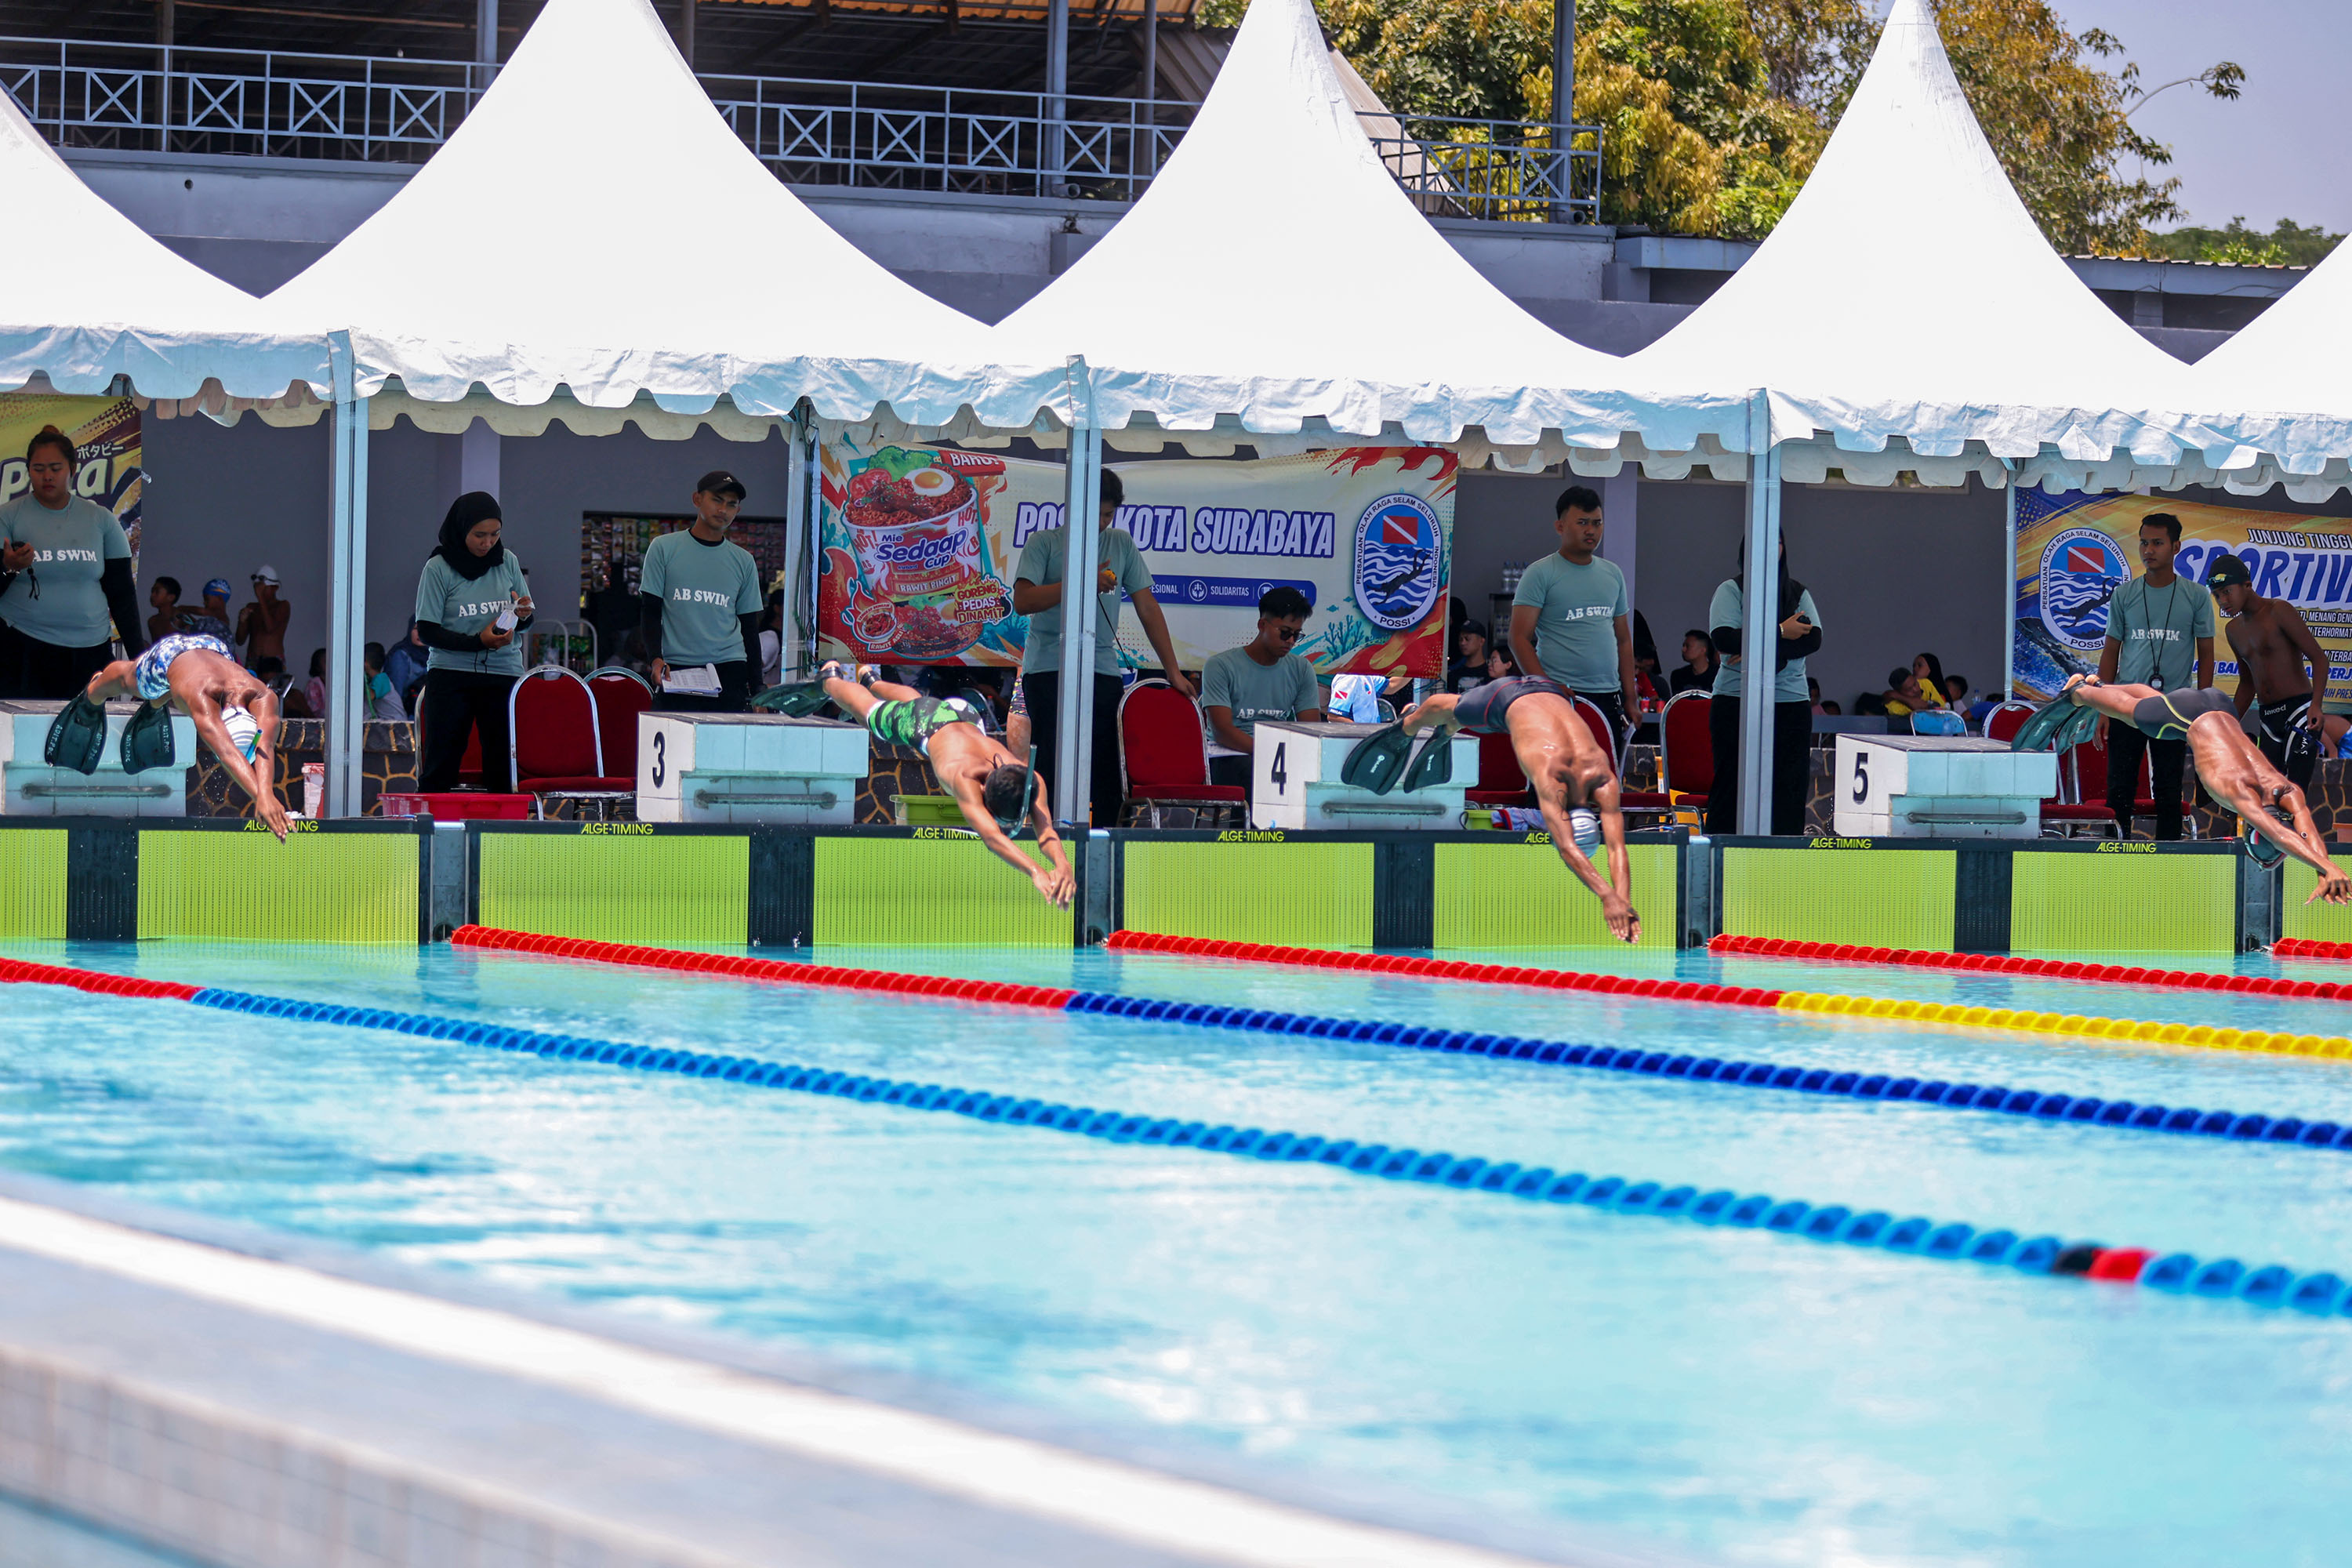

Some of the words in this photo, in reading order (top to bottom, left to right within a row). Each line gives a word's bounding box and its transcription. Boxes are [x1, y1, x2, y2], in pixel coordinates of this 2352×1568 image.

[77, 441, 124, 459] ポタビー
[1359, 511, 1373, 533] OLAH
[1372, 498, 1392, 512] RAGA
[1392, 496, 1416, 506] SELAM
[1417, 503, 1439, 537] SELURUH
[1113, 506, 1186, 552] KOTA
[1192, 506, 1334, 558] SURABAYA
[2248, 528, 2306, 547] JUNJUNG
[876, 529, 967, 562] Sedaap
[2043, 543, 2056, 563] OLAH
[2056, 531, 2075, 544] RAGA
[2075, 530, 2100, 539] SELAM
[2100, 536, 2126, 567] SELURUH
[32, 550, 53, 562] AB
[57, 550, 97, 562] SWIM
[924, 554, 950, 568] Cup
[900, 583, 929, 593] RAWIT
[956, 583, 997, 600] GORENG
[1210, 586, 1250, 597] SOLIDARITAS
[673, 588, 691, 601] AB
[694, 590, 730, 607] SWIM
[963, 596, 996, 611] PEDAS
[458, 603, 477, 617] AB
[957, 608, 1004, 625] DINAMIT
[1566, 608, 1584, 620] AB
[2308, 612, 2336, 622] MENANG
[1379, 616, 1411, 627] POSSI
[2131, 629, 2145, 640] AB
[2147, 629, 2180, 641] SWIM
[652, 731, 666, 789] 3
[1271, 742, 1287, 795] 4
[1853, 752, 1869, 805] 5
